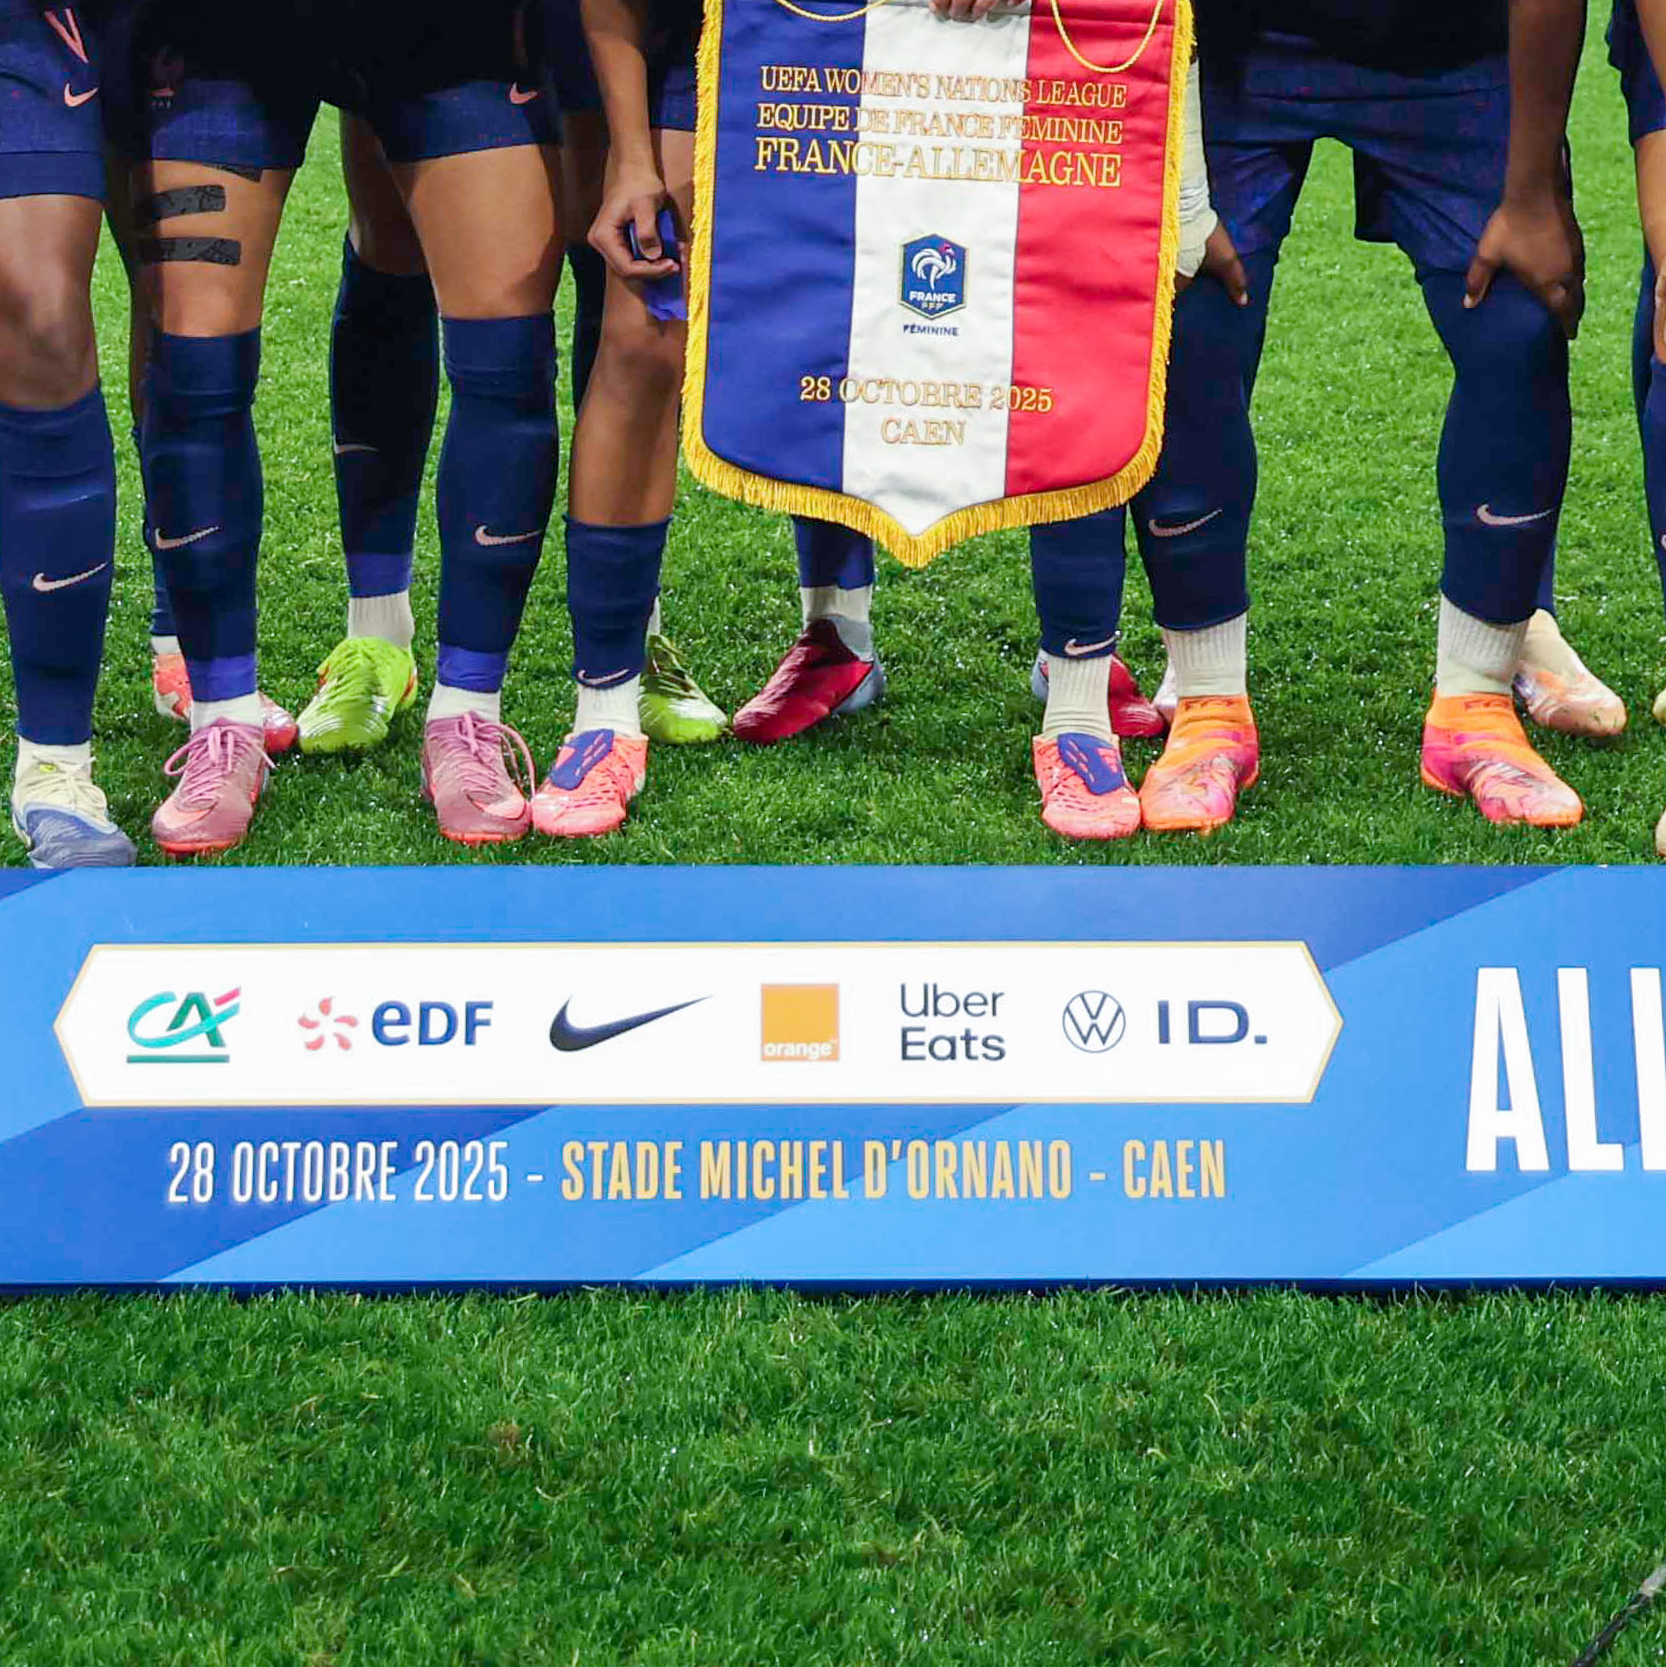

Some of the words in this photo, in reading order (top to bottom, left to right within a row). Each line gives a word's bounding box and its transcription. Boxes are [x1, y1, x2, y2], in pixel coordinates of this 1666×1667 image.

[760, 65, 822, 93] UEFA
[824, 68, 930, 99] WOMEN'S
[935, 74, 1031, 103] NATIONS
[1036, 80, 1127, 109] LEAGUE
[757, 103, 849, 132] EQUIPE
[854, 109, 889, 133] DE
[894, 111, 994, 139] FRANCE
[998, 116, 1123, 145] FEMININE
[754, 136, 1122, 188] FRANCE-ALLEMAGNE
[909, 291, 956, 303] FRANCE
[903, 323, 959, 337] FÉMININE
[800, 376, 831, 401] 28
[839, 377, 983, 409] OCTOBRE
[989, 386, 1054, 413] 2025
[881, 417, 966, 446] CAEN
[900, 982, 1006, 1018] Uber
[1158, 1000, 1268, 1045] ID.
[763, 1039, 832, 1060] orange
[900, 1025, 1007, 1062] Eats
[167, 1141, 214, 1204] 28
[233, 1141, 397, 1203] OCTOBRE
[414, 1141, 509, 1203] 2025
[561, 1141, 683, 1202] STADE
[699, 1140, 849, 1200] MICHEL
[864, 1140, 1072, 1200] D'ORNANO
[1123, 1139, 1226, 1199] CAEN
